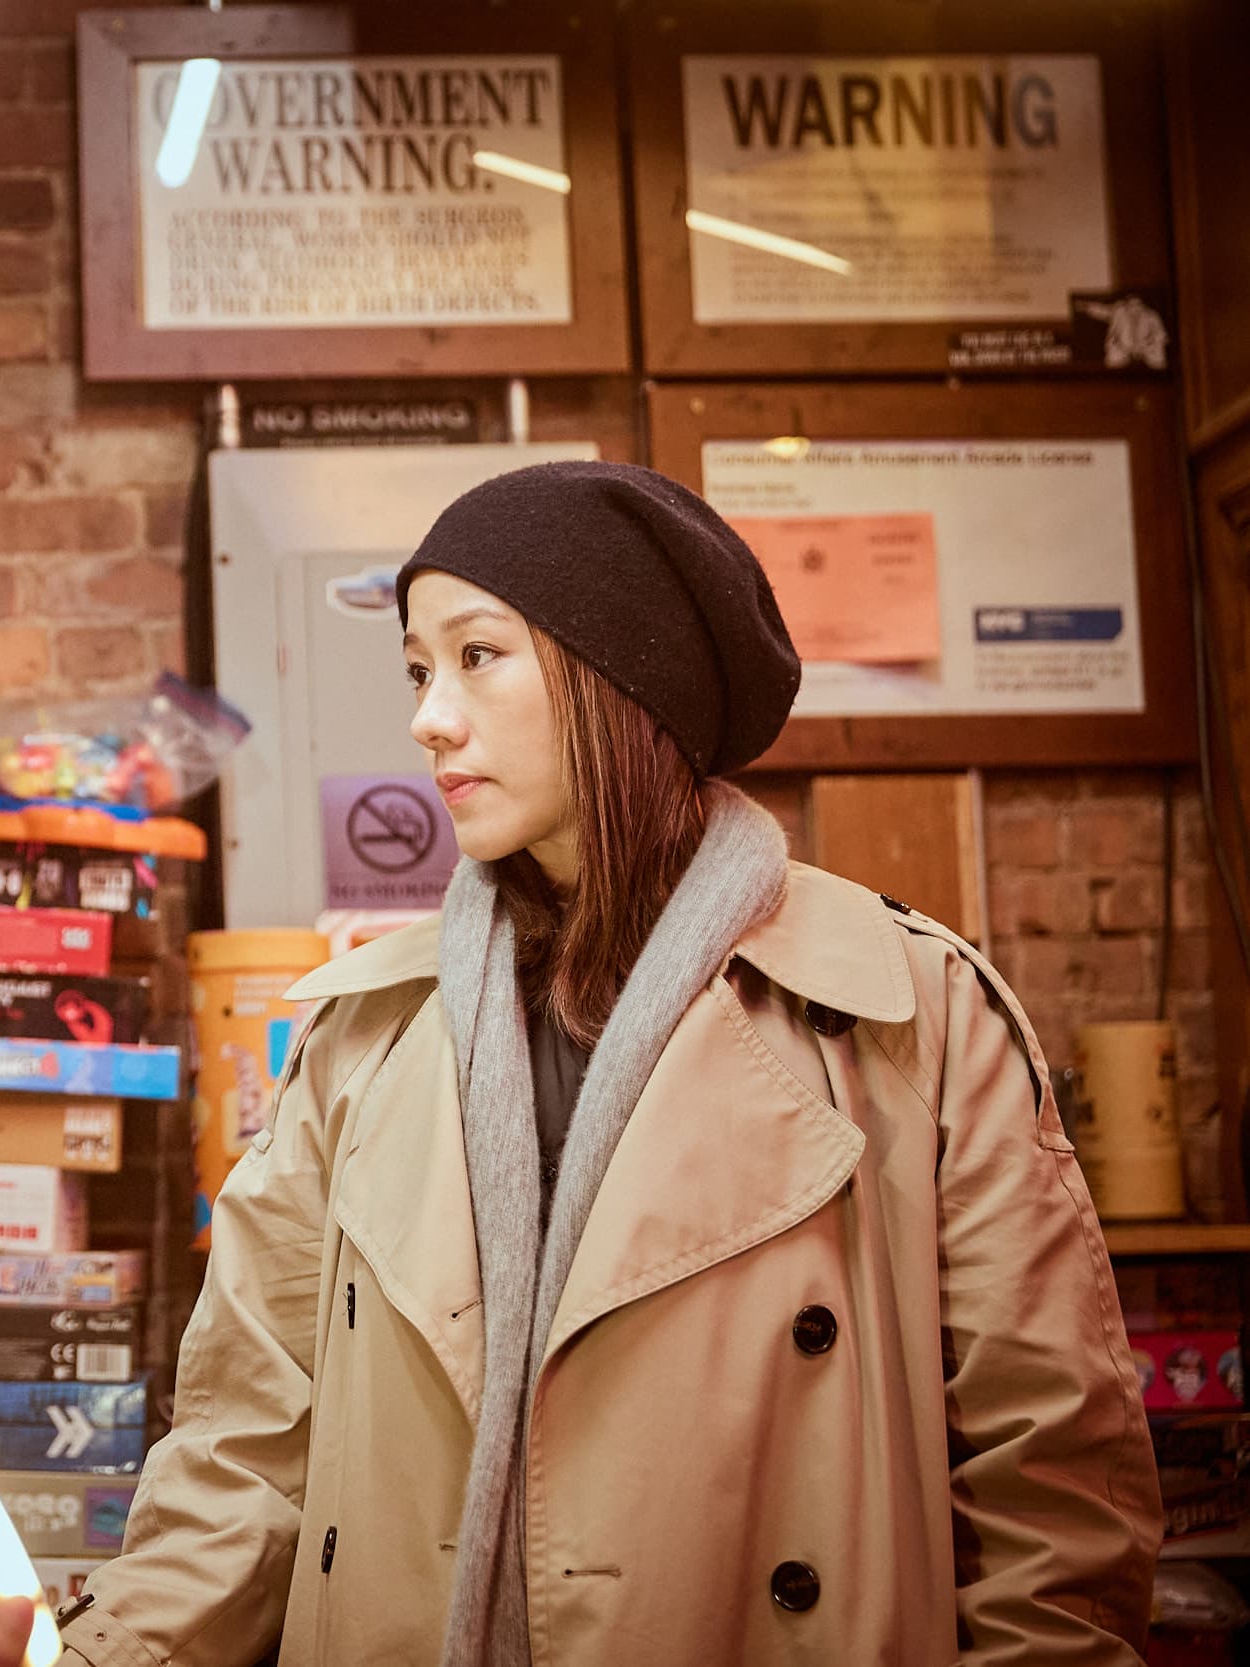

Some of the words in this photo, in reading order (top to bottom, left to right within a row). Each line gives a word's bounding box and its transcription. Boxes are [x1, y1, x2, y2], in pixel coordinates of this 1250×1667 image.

[721, 73, 1059, 150] WARNING
[210, 135, 494, 194] WARNING.
[252, 409, 305, 432] NO
[312, 405, 470, 430] SMOKING
